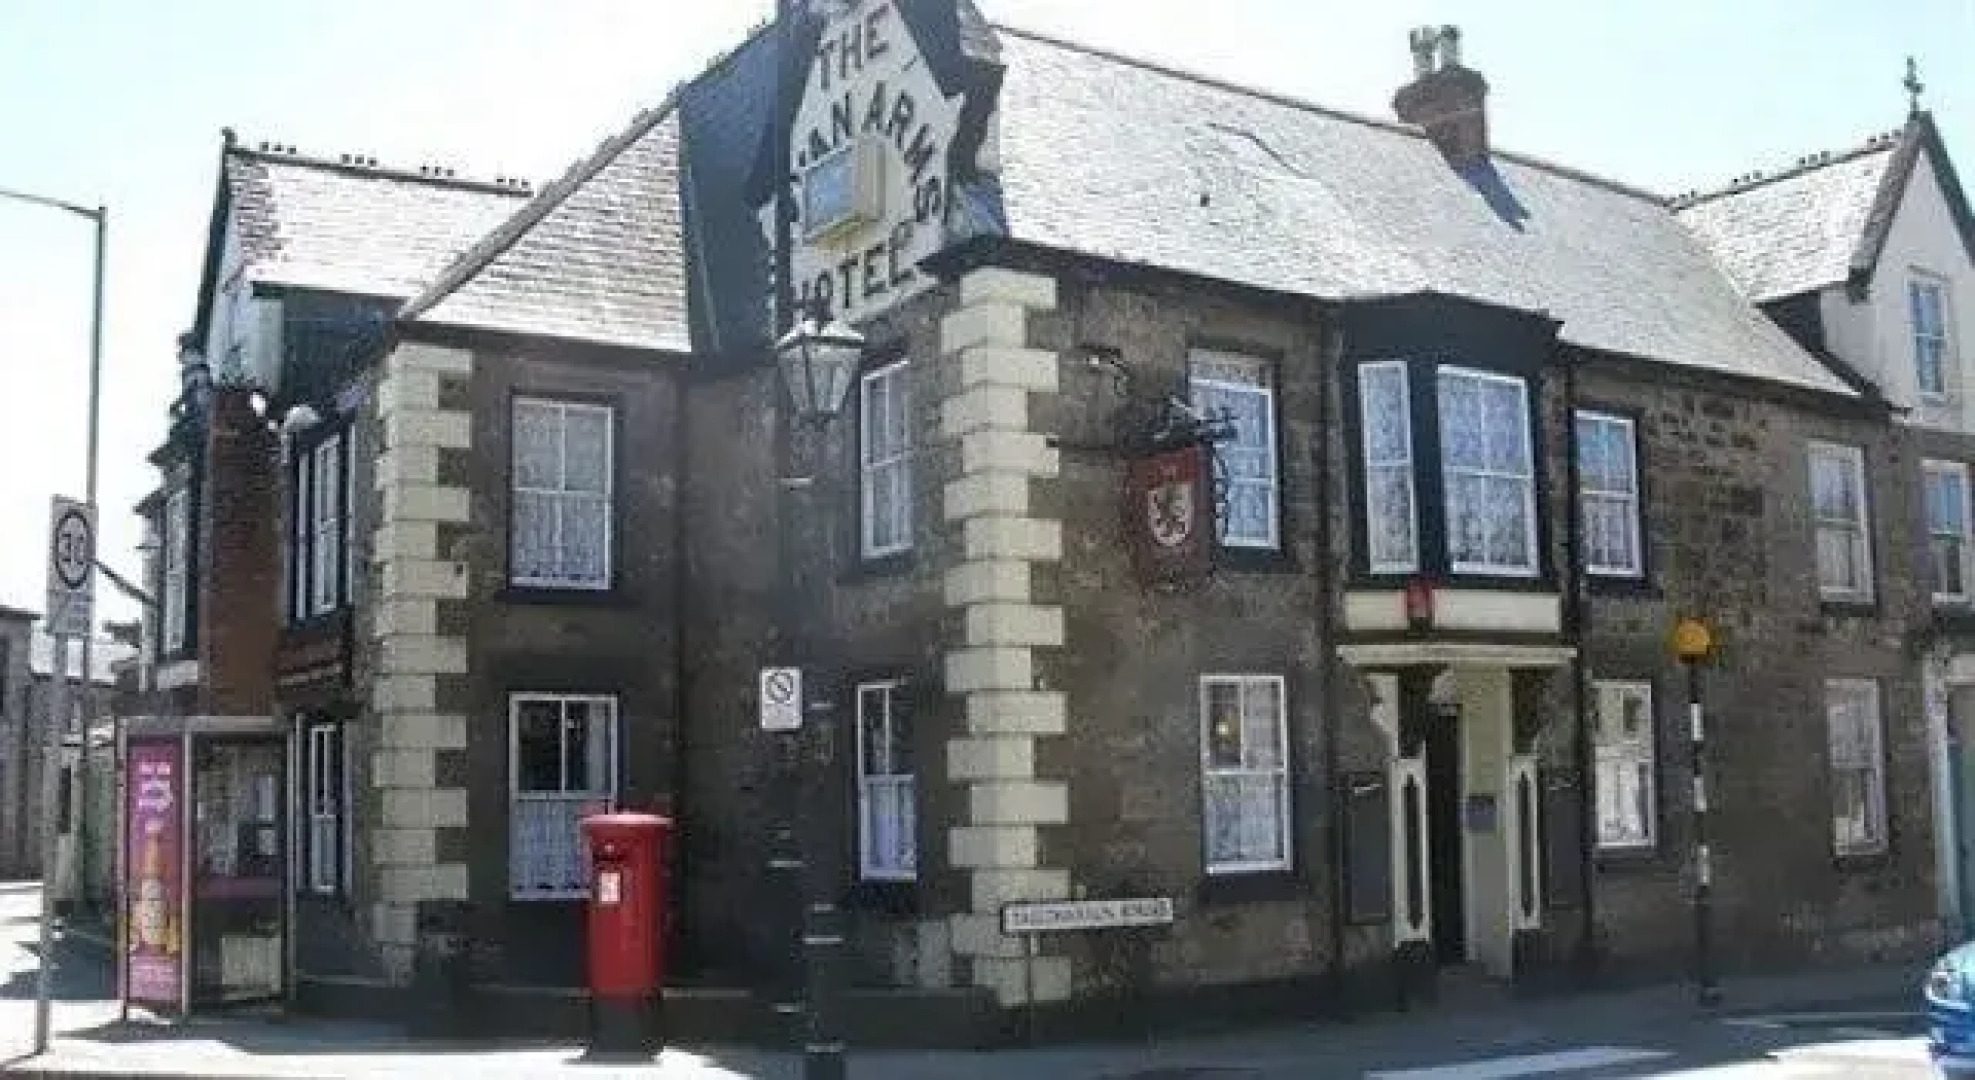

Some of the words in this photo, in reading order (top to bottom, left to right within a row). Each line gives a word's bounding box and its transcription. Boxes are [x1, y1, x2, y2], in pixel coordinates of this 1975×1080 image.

[816, 4, 889, 90] THE
[861, 81, 941, 222] ARMS
[60, 532, 87, 565] 30
